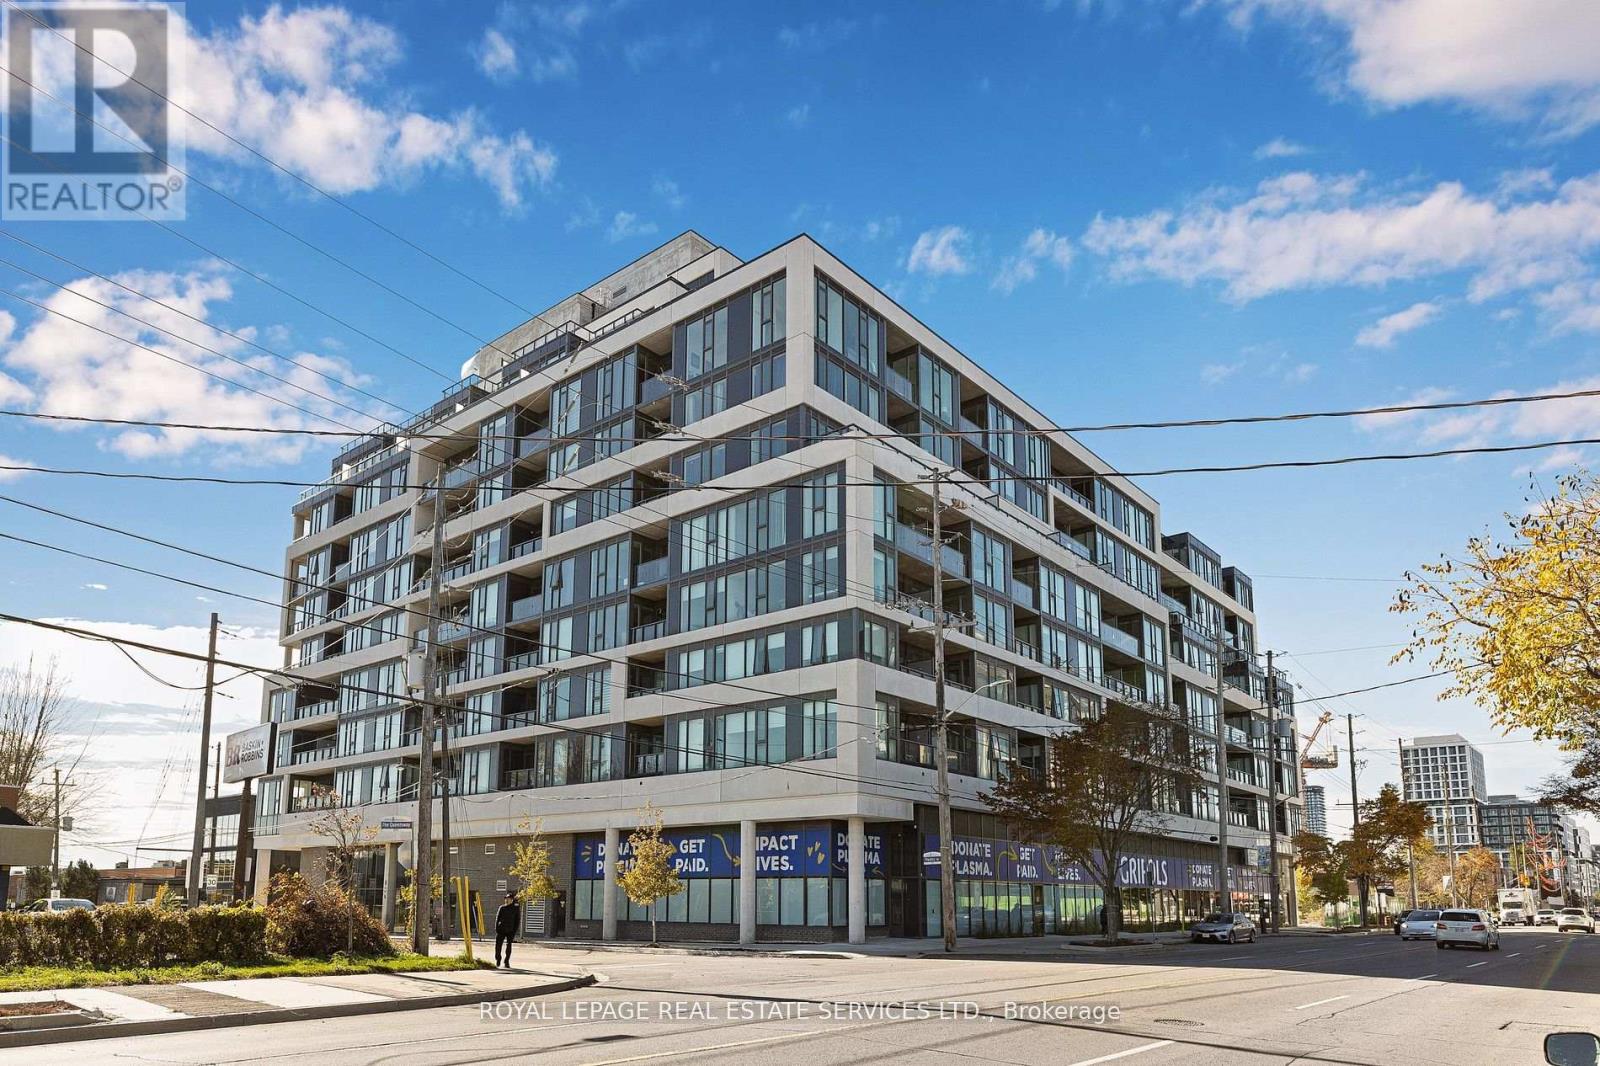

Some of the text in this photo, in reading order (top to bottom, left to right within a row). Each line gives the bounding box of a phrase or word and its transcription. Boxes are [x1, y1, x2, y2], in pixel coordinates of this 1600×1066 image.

[241, 749, 264, 762] ROBBINS
[680, 839, 705, 853] GET
[755, 835, 798, 850] PACT
[951, 841, 991, 858] DONATE
[1020, 847, 1035, 860] GET
[676, 858, 709, 872] PAID.
[756, 855, 794, 871] IVES.
